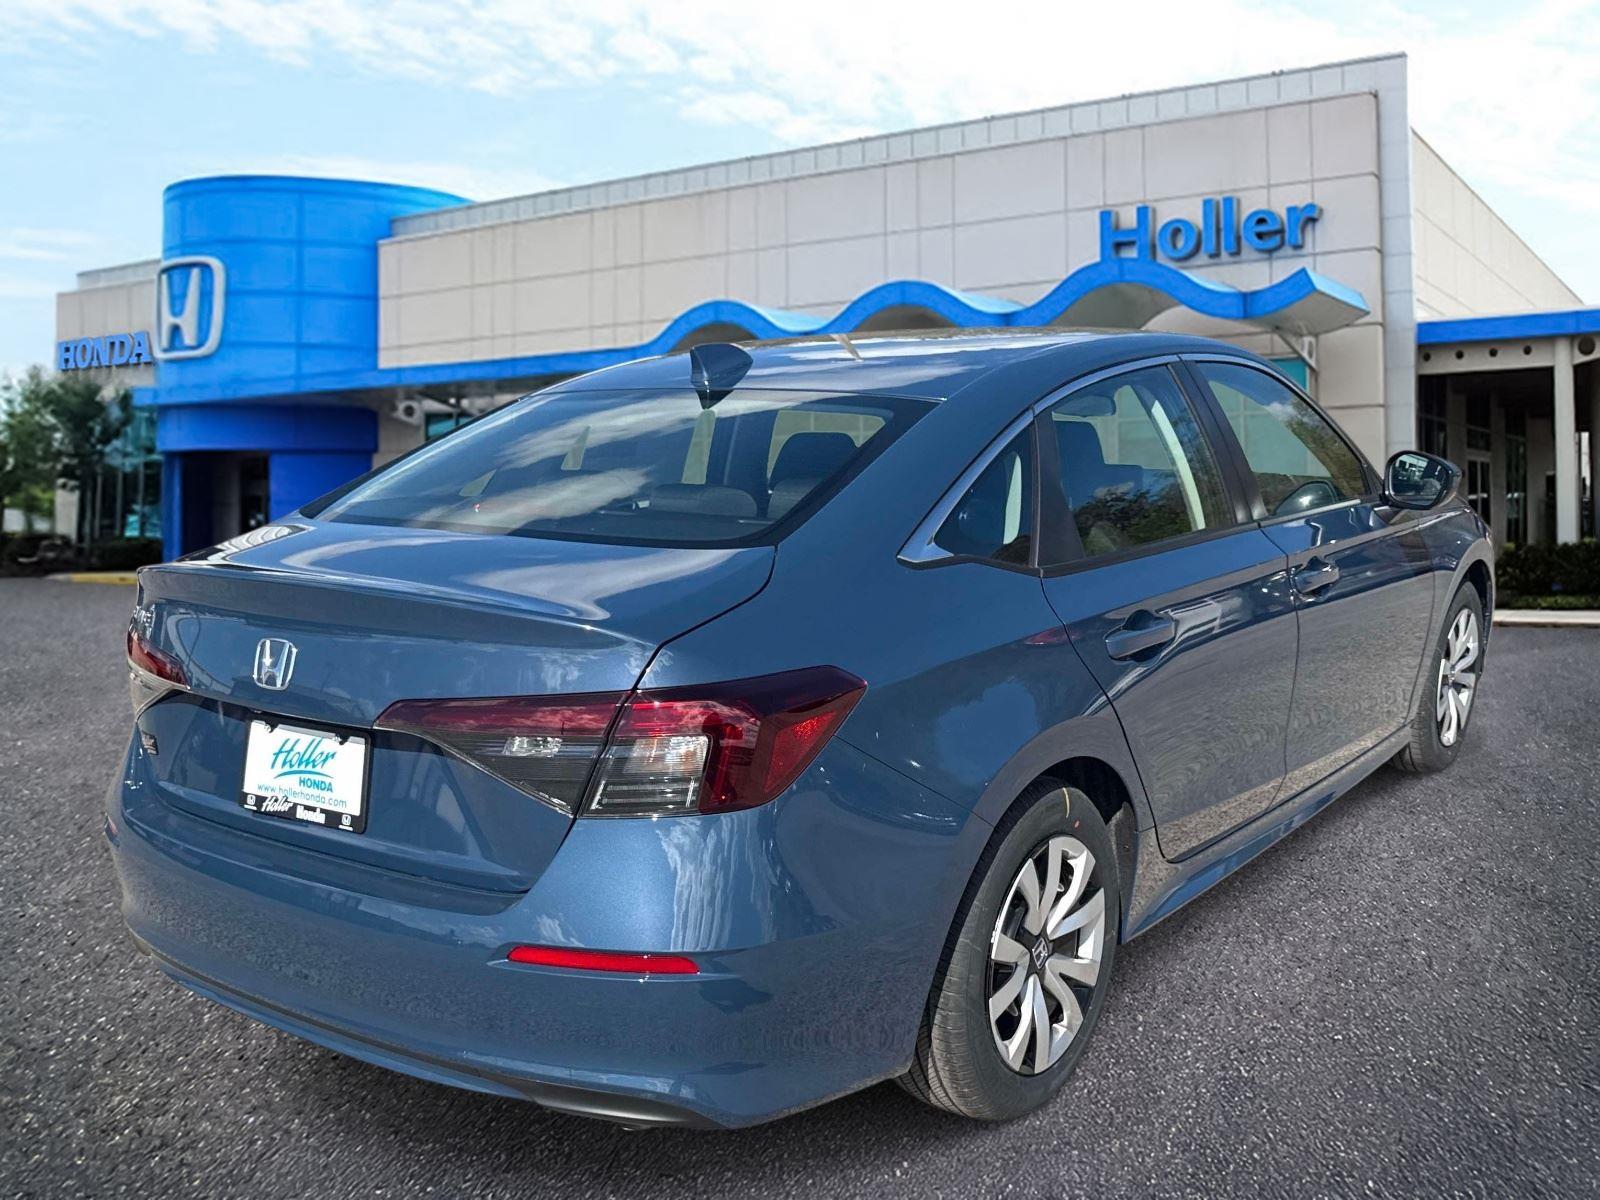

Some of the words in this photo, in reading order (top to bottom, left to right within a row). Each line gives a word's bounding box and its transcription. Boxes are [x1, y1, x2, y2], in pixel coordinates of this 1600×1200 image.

[1099, 195, 1322, 263] Holler
[58, 330, 152, 370] HONDA
[270, 737, 337, 770] Holler
[257, 782, 348, 809] www.hollerhonda.com
[298, 776, 334, 794] HONDA
[261, 796, 294, 812] Holler
